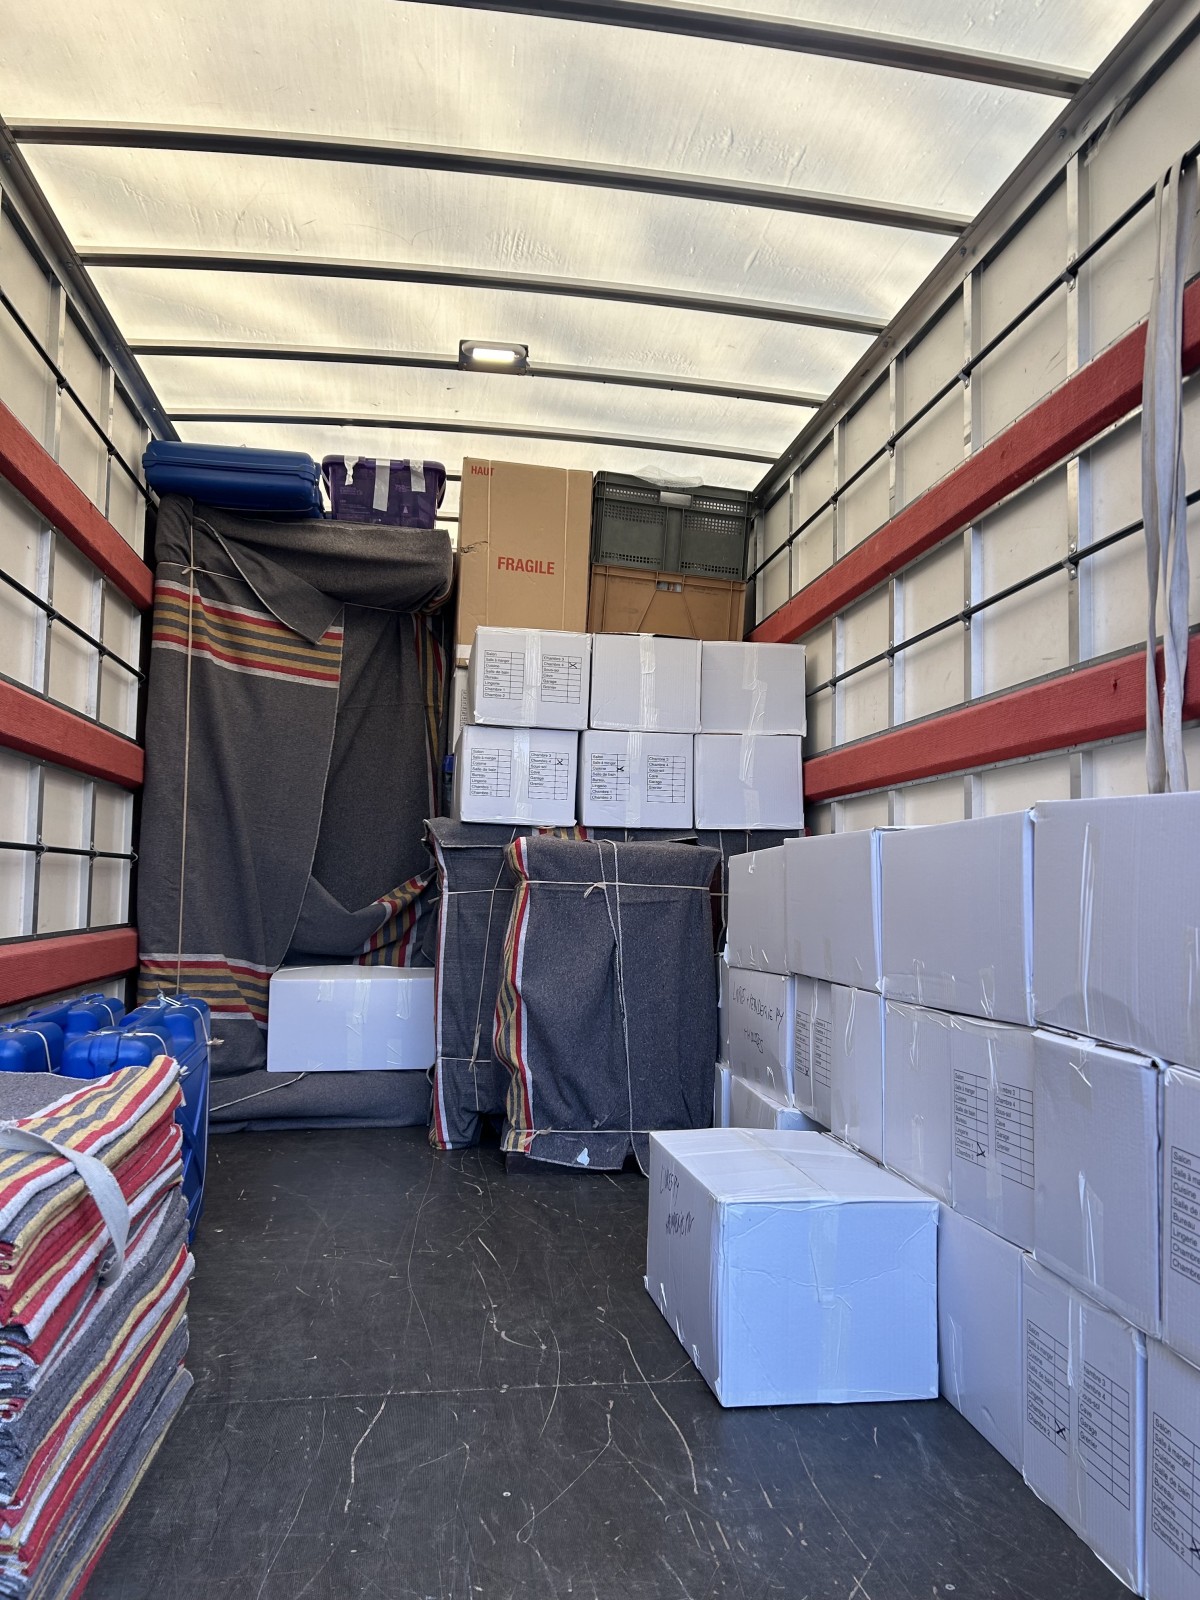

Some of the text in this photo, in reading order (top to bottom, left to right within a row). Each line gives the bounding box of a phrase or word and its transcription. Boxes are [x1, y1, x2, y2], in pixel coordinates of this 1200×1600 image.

[471, 465, 495, 477] HAUT
[497, 556, 555, 575] FRAGILE
[1173, 1151, 1192, 1167] Salon
[1173, 1166, 1187, 1180] Salle
[1173, 1182, 1197, 1200] Cuisine
[1173, 1197, 1199, 1216] Salle de
[1173, 1212, 1196, 1230] Bureau
[1173, 1227, 1198, 1247] Lingerie
[1083, 1365, 1101, 1384] hambre
[1083, 1378, 1102, 1398] hambre
[1082, 1393, 1100, 1410] ous-sol
[1155, 1418, 1172, 1438] Salon
[1155, 1432, 1167, 1449] Salle
[1172, 1448, 1191, 1468] manger
[1155, 1447, 1176, 1472] Cuisine
[1154, 1477, 1175, 1501] Bureau
[1155, 1462, 1191, 1500] Salle de bain
[1154, 1492, 1176, 1518] Lingerie
[1154, 1507, 1180, 1537] Chambre
[1153, 1521, 1180, 1552] Chambre
